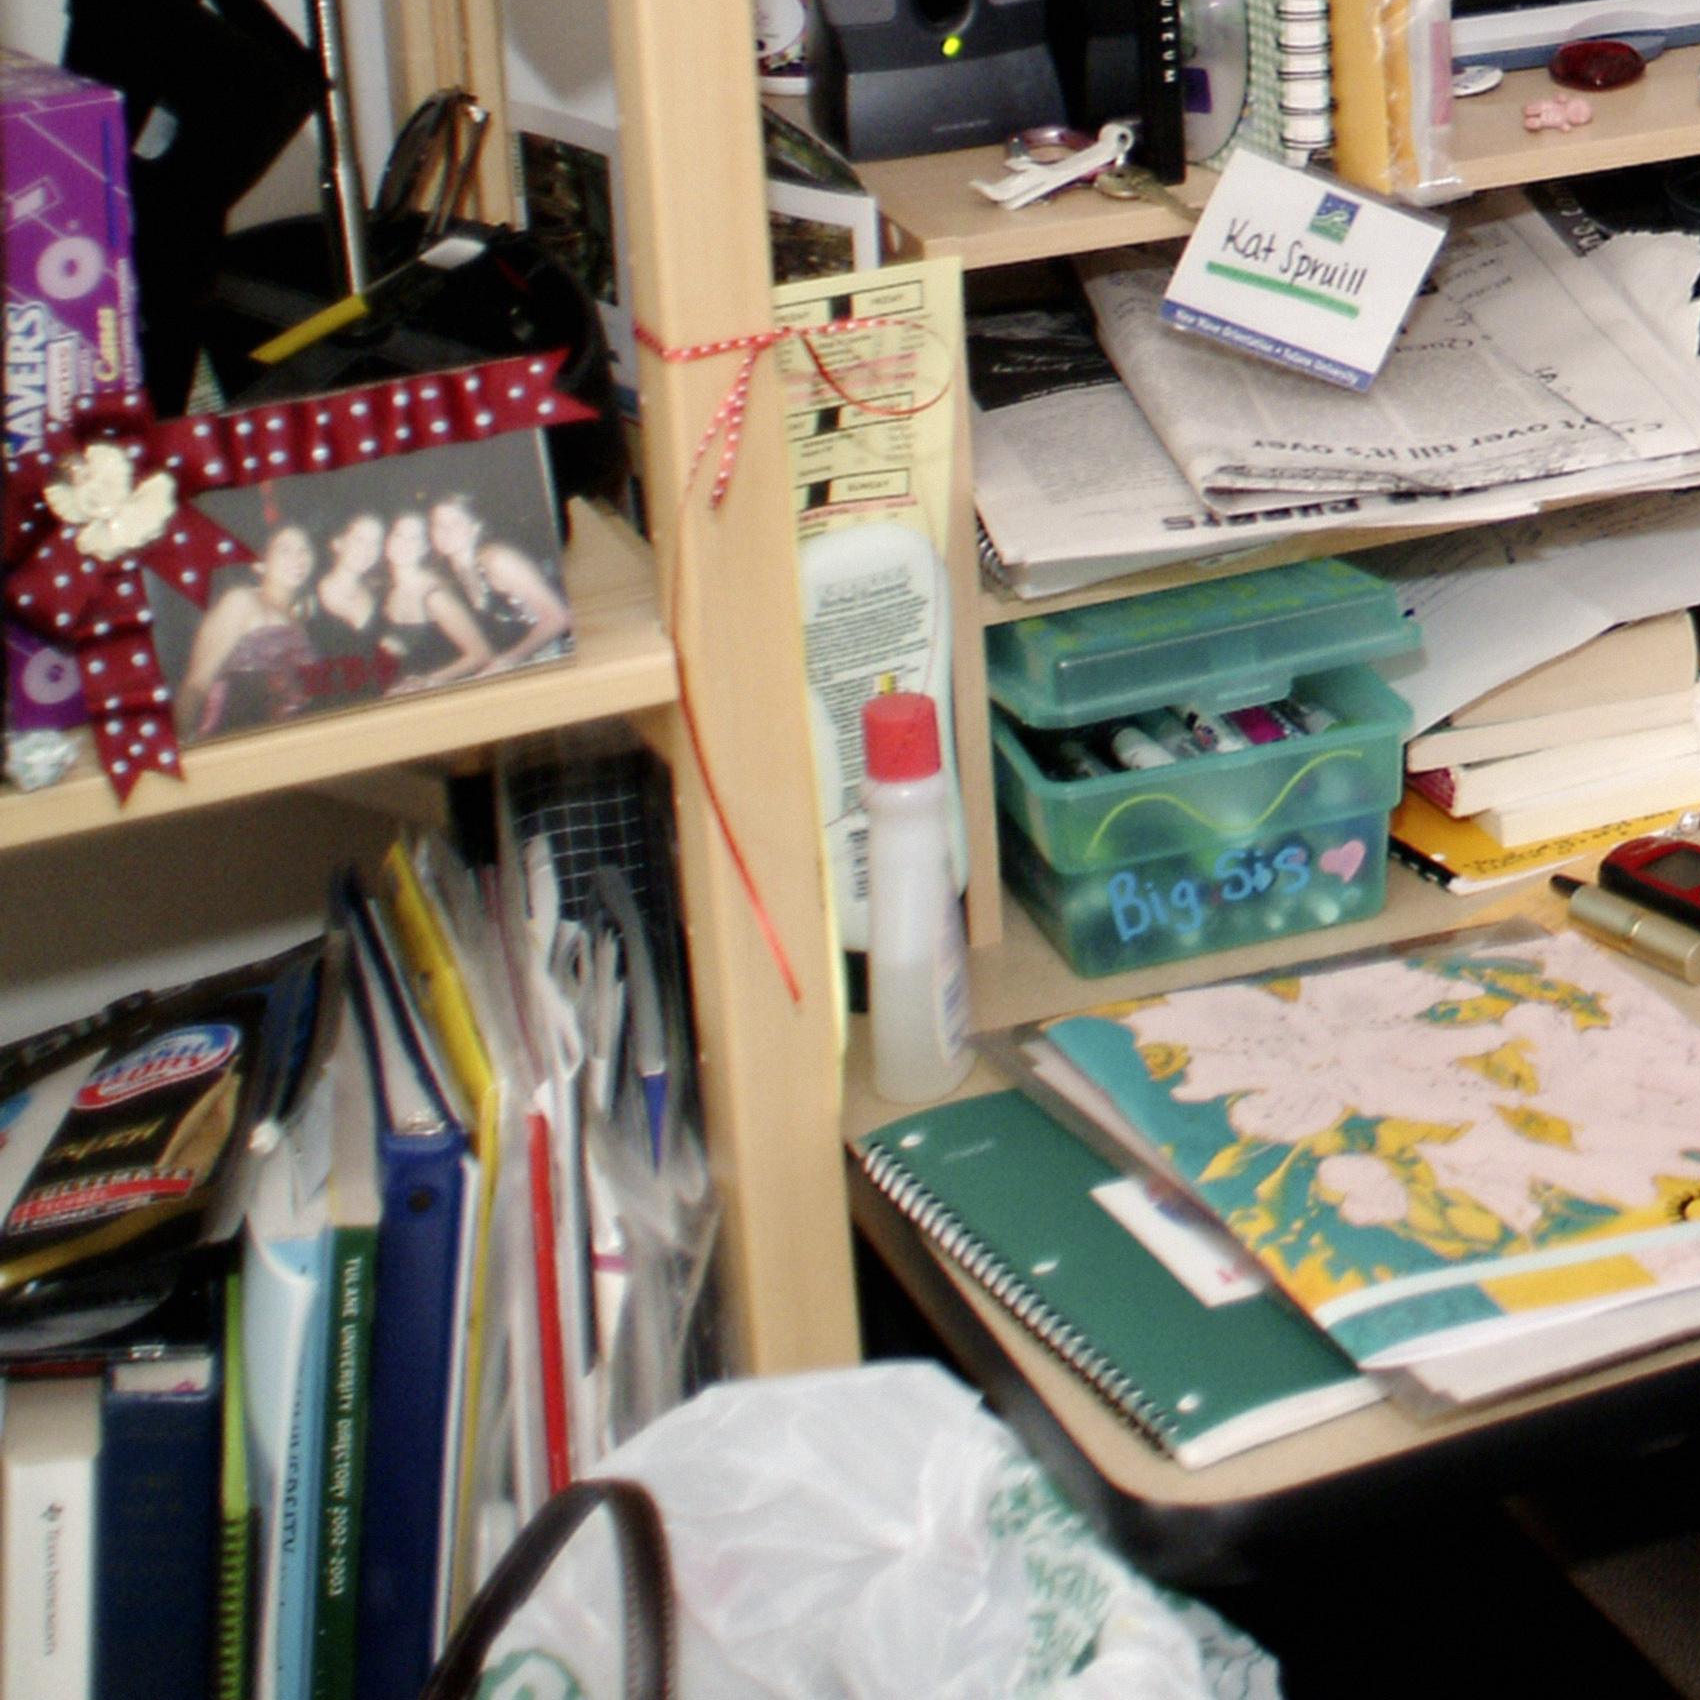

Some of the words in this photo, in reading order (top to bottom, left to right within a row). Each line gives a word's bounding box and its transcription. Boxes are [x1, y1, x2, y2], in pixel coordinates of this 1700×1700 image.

[1222, 216, 1277, 263] Kat
[1279, 239, 1369, 296] Spruill
[1195, 313, 1221, 334] Wave
[1221, 321, 1274, 352] Orientation
[1283, 345, 1313, 367] Tulane
[1313, 353, 1359, 386] University
[1252, 436, 1327, 456] over
[1344, 441, 1397, 464] it's
[1410, 438, 1458, 462] till
[1473, 421, 1548, 448] over
[1107, 869, 1205, 943] Big
[1213, 845, 1312, 902] Sis
[339, 1257, 362, 1319] TULANE
[335, 1323, 358, 1413] UNIVERSITY
[328, 1417, 354, 1499] DIRECTORY
